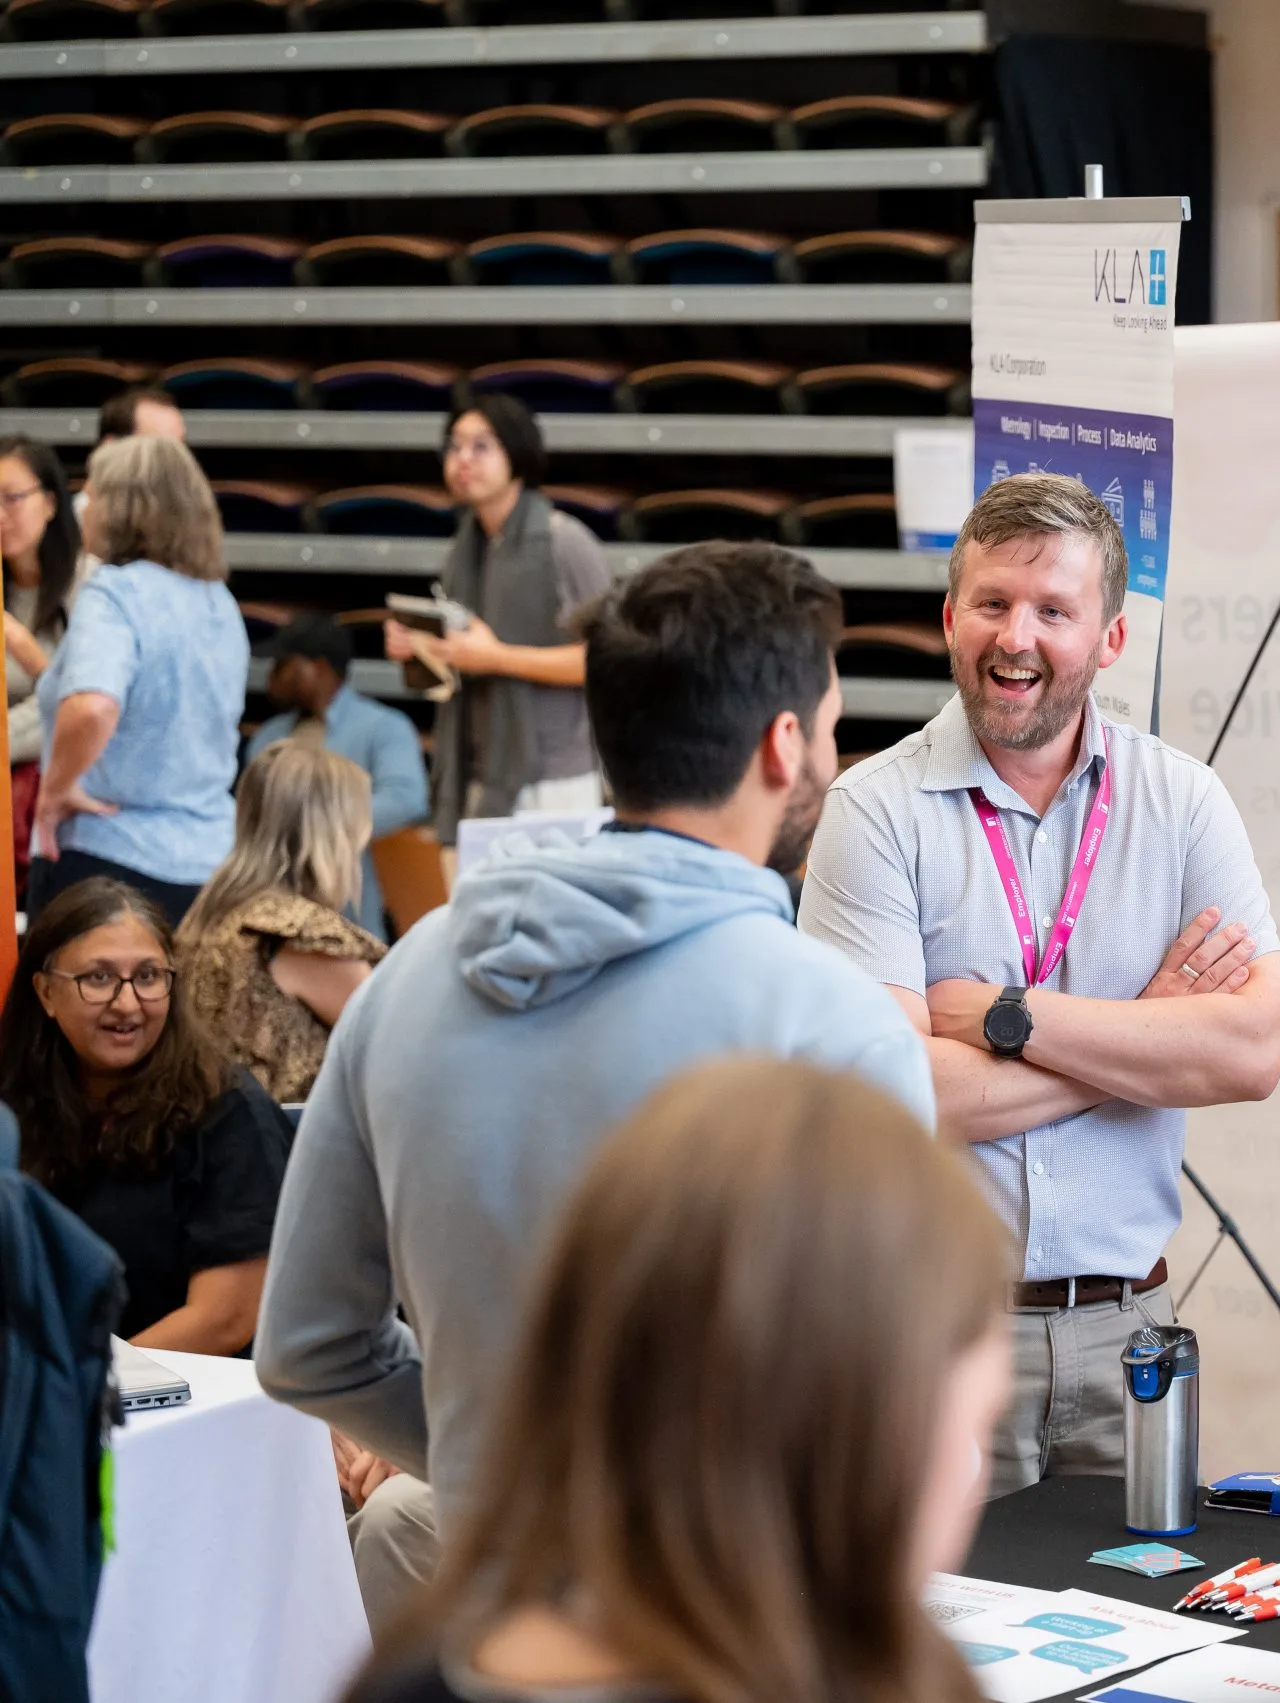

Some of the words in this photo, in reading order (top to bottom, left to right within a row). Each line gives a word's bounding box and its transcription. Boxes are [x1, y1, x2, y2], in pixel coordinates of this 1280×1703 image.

[1006, 354, 1047, 380] Corporation
[1038, 420, 1070, 443] Inspection
[1077, 424, 1102, 445] Process
[1110, 428, 1127, 447] Data
[1126, 431, 1158, 456] Analytics
[1083, 827, 1102, 868] Employer
[1009, 877, 1026, 918] Employer
